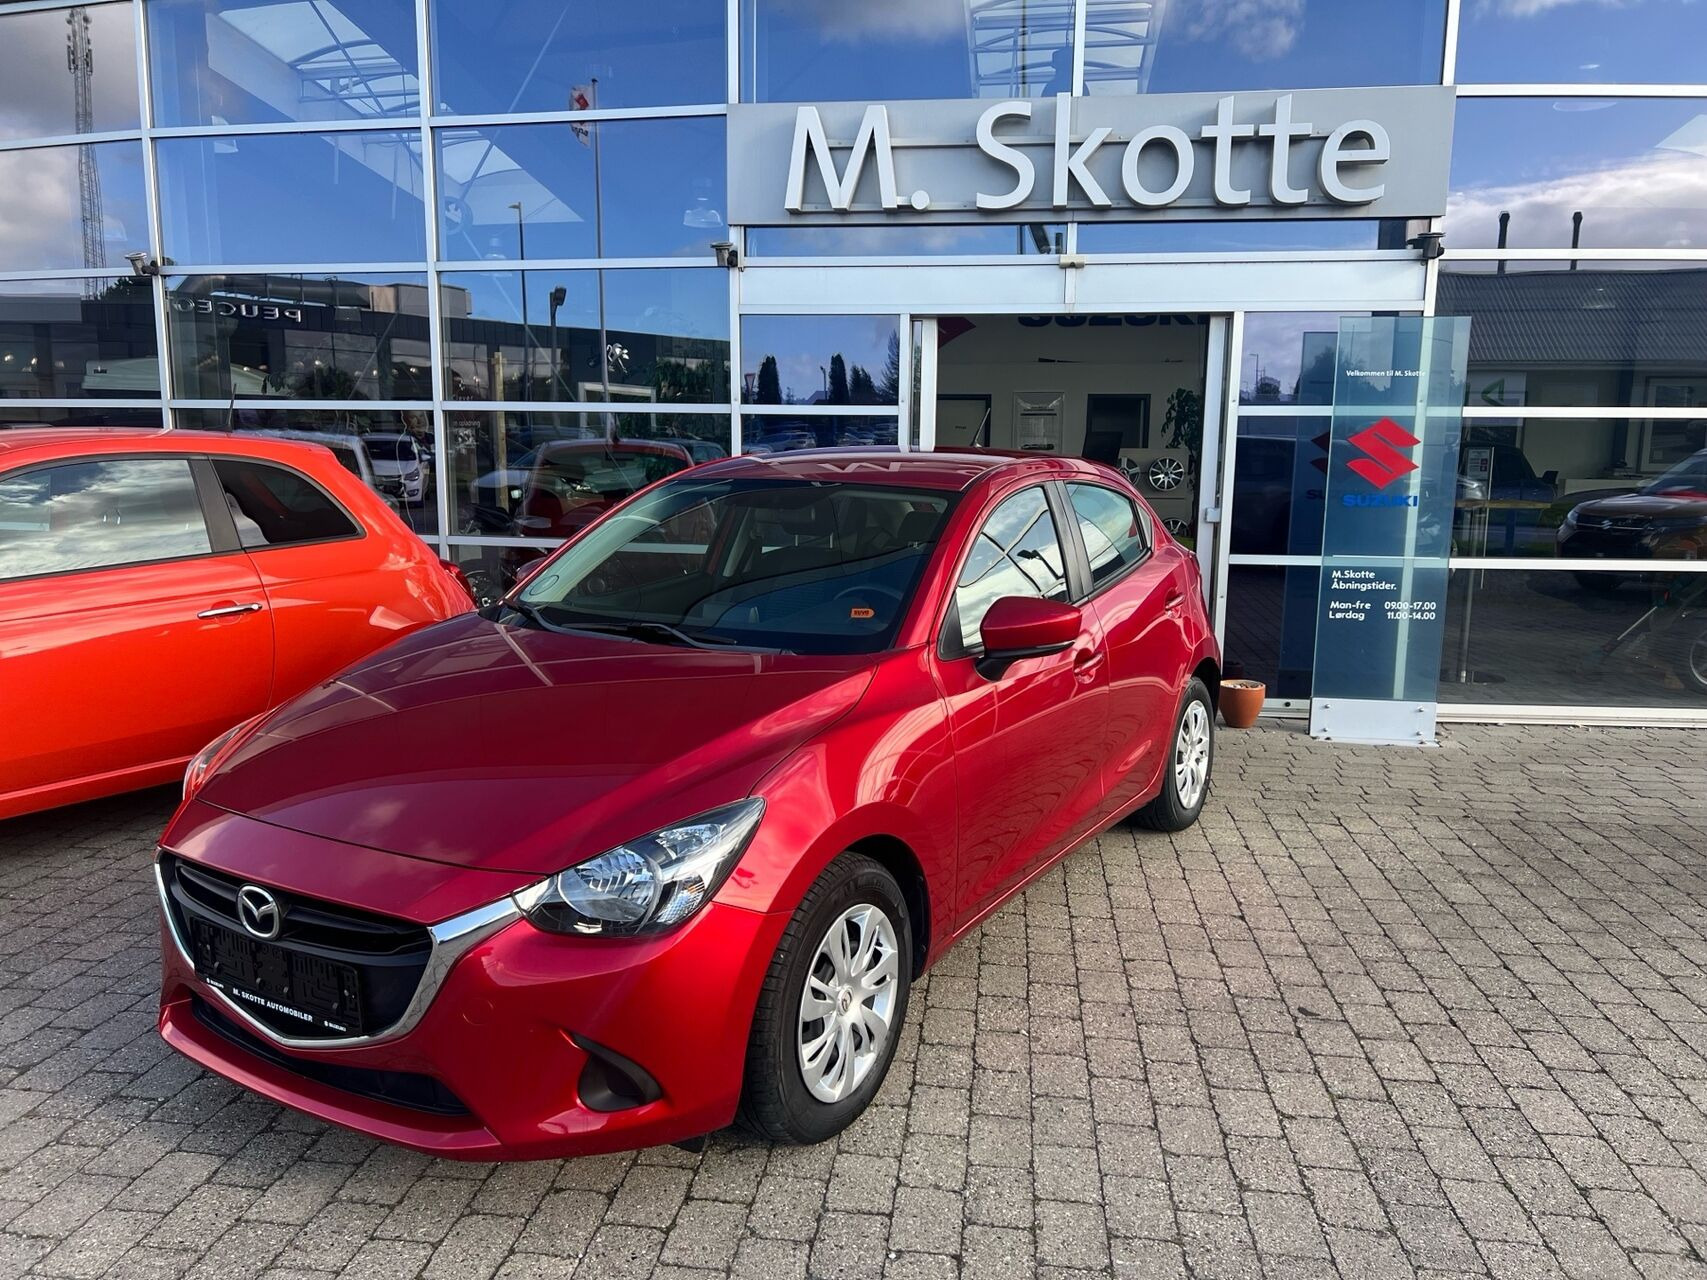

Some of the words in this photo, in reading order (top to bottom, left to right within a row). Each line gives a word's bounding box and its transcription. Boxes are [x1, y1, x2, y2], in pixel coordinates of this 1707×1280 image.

[784, 103, 931, 213] M.
[975, 92, 1391, 211] Skotte
[1386, 369, 1394, 377] til
[1404, 369, 1426, 377] Skotte
[1342, 494, 1419, 508] SUZUKI
[1331, 569, 1376, 579] M.Skotte
[1331, 579, 1397, 591] Åbningstider.
[1329, 600, 1372, 610] Man-fre
[1328, 610, 1366, 621] Lørdag
[1386, 611, 1436, 620] 11.00-14.00
[241, 991, 265, 1005] SKOTTE
[266, 1001, 313, 1022] AUTOMOBILER
